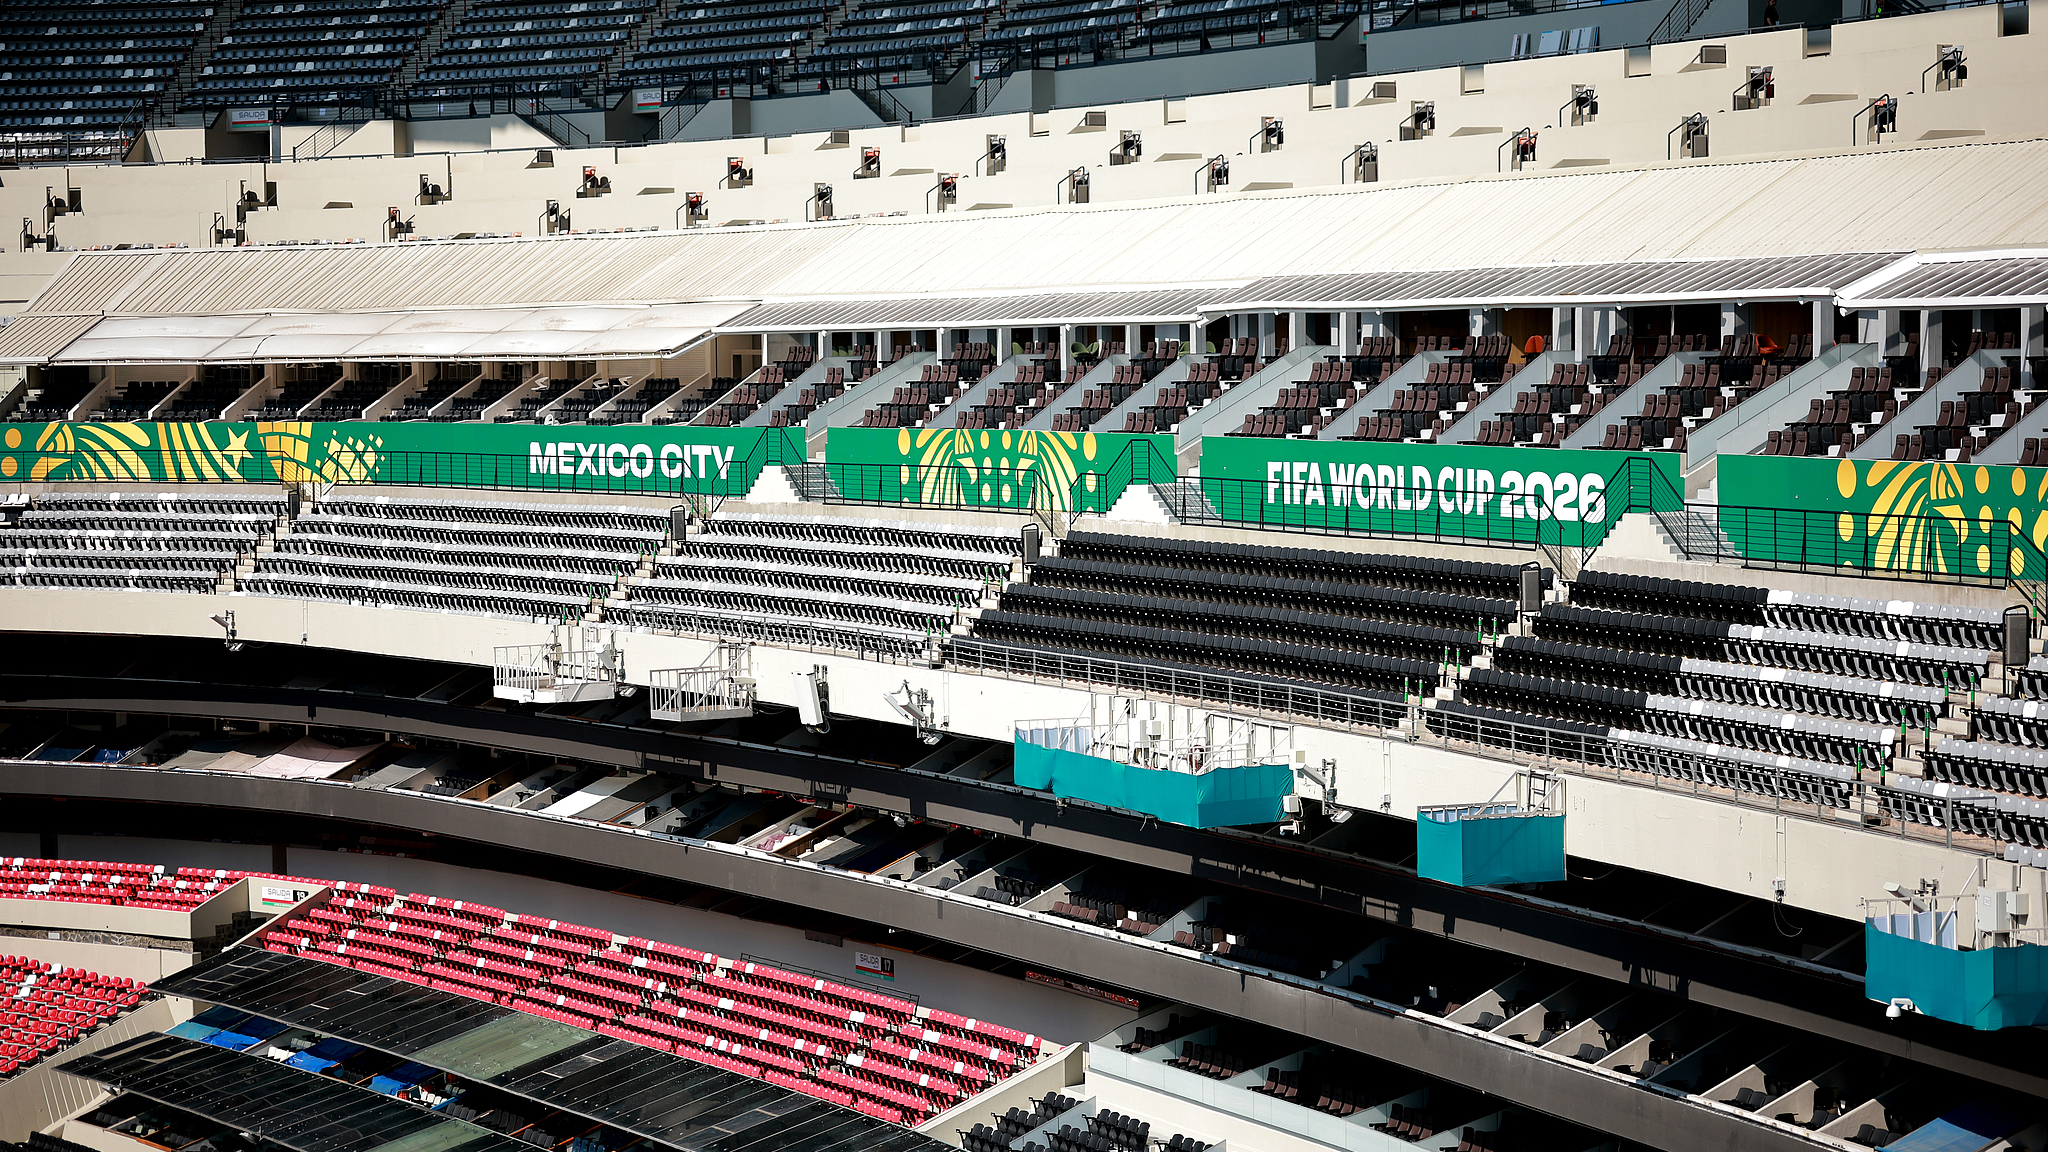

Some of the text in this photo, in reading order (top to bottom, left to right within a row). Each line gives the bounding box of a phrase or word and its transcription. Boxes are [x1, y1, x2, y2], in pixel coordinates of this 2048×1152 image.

[643, 92, 663, 100] SALID
[238, 110, 266, 119] SALIDA
[529, 441, 735, 480] MEXICO CITY
[1266, 461, 1606, 524] FIFA WORLD CUP 2026
[267, 888, 291, 897] SALIDA
[860, 953, 892, 972] SALIDA 17
